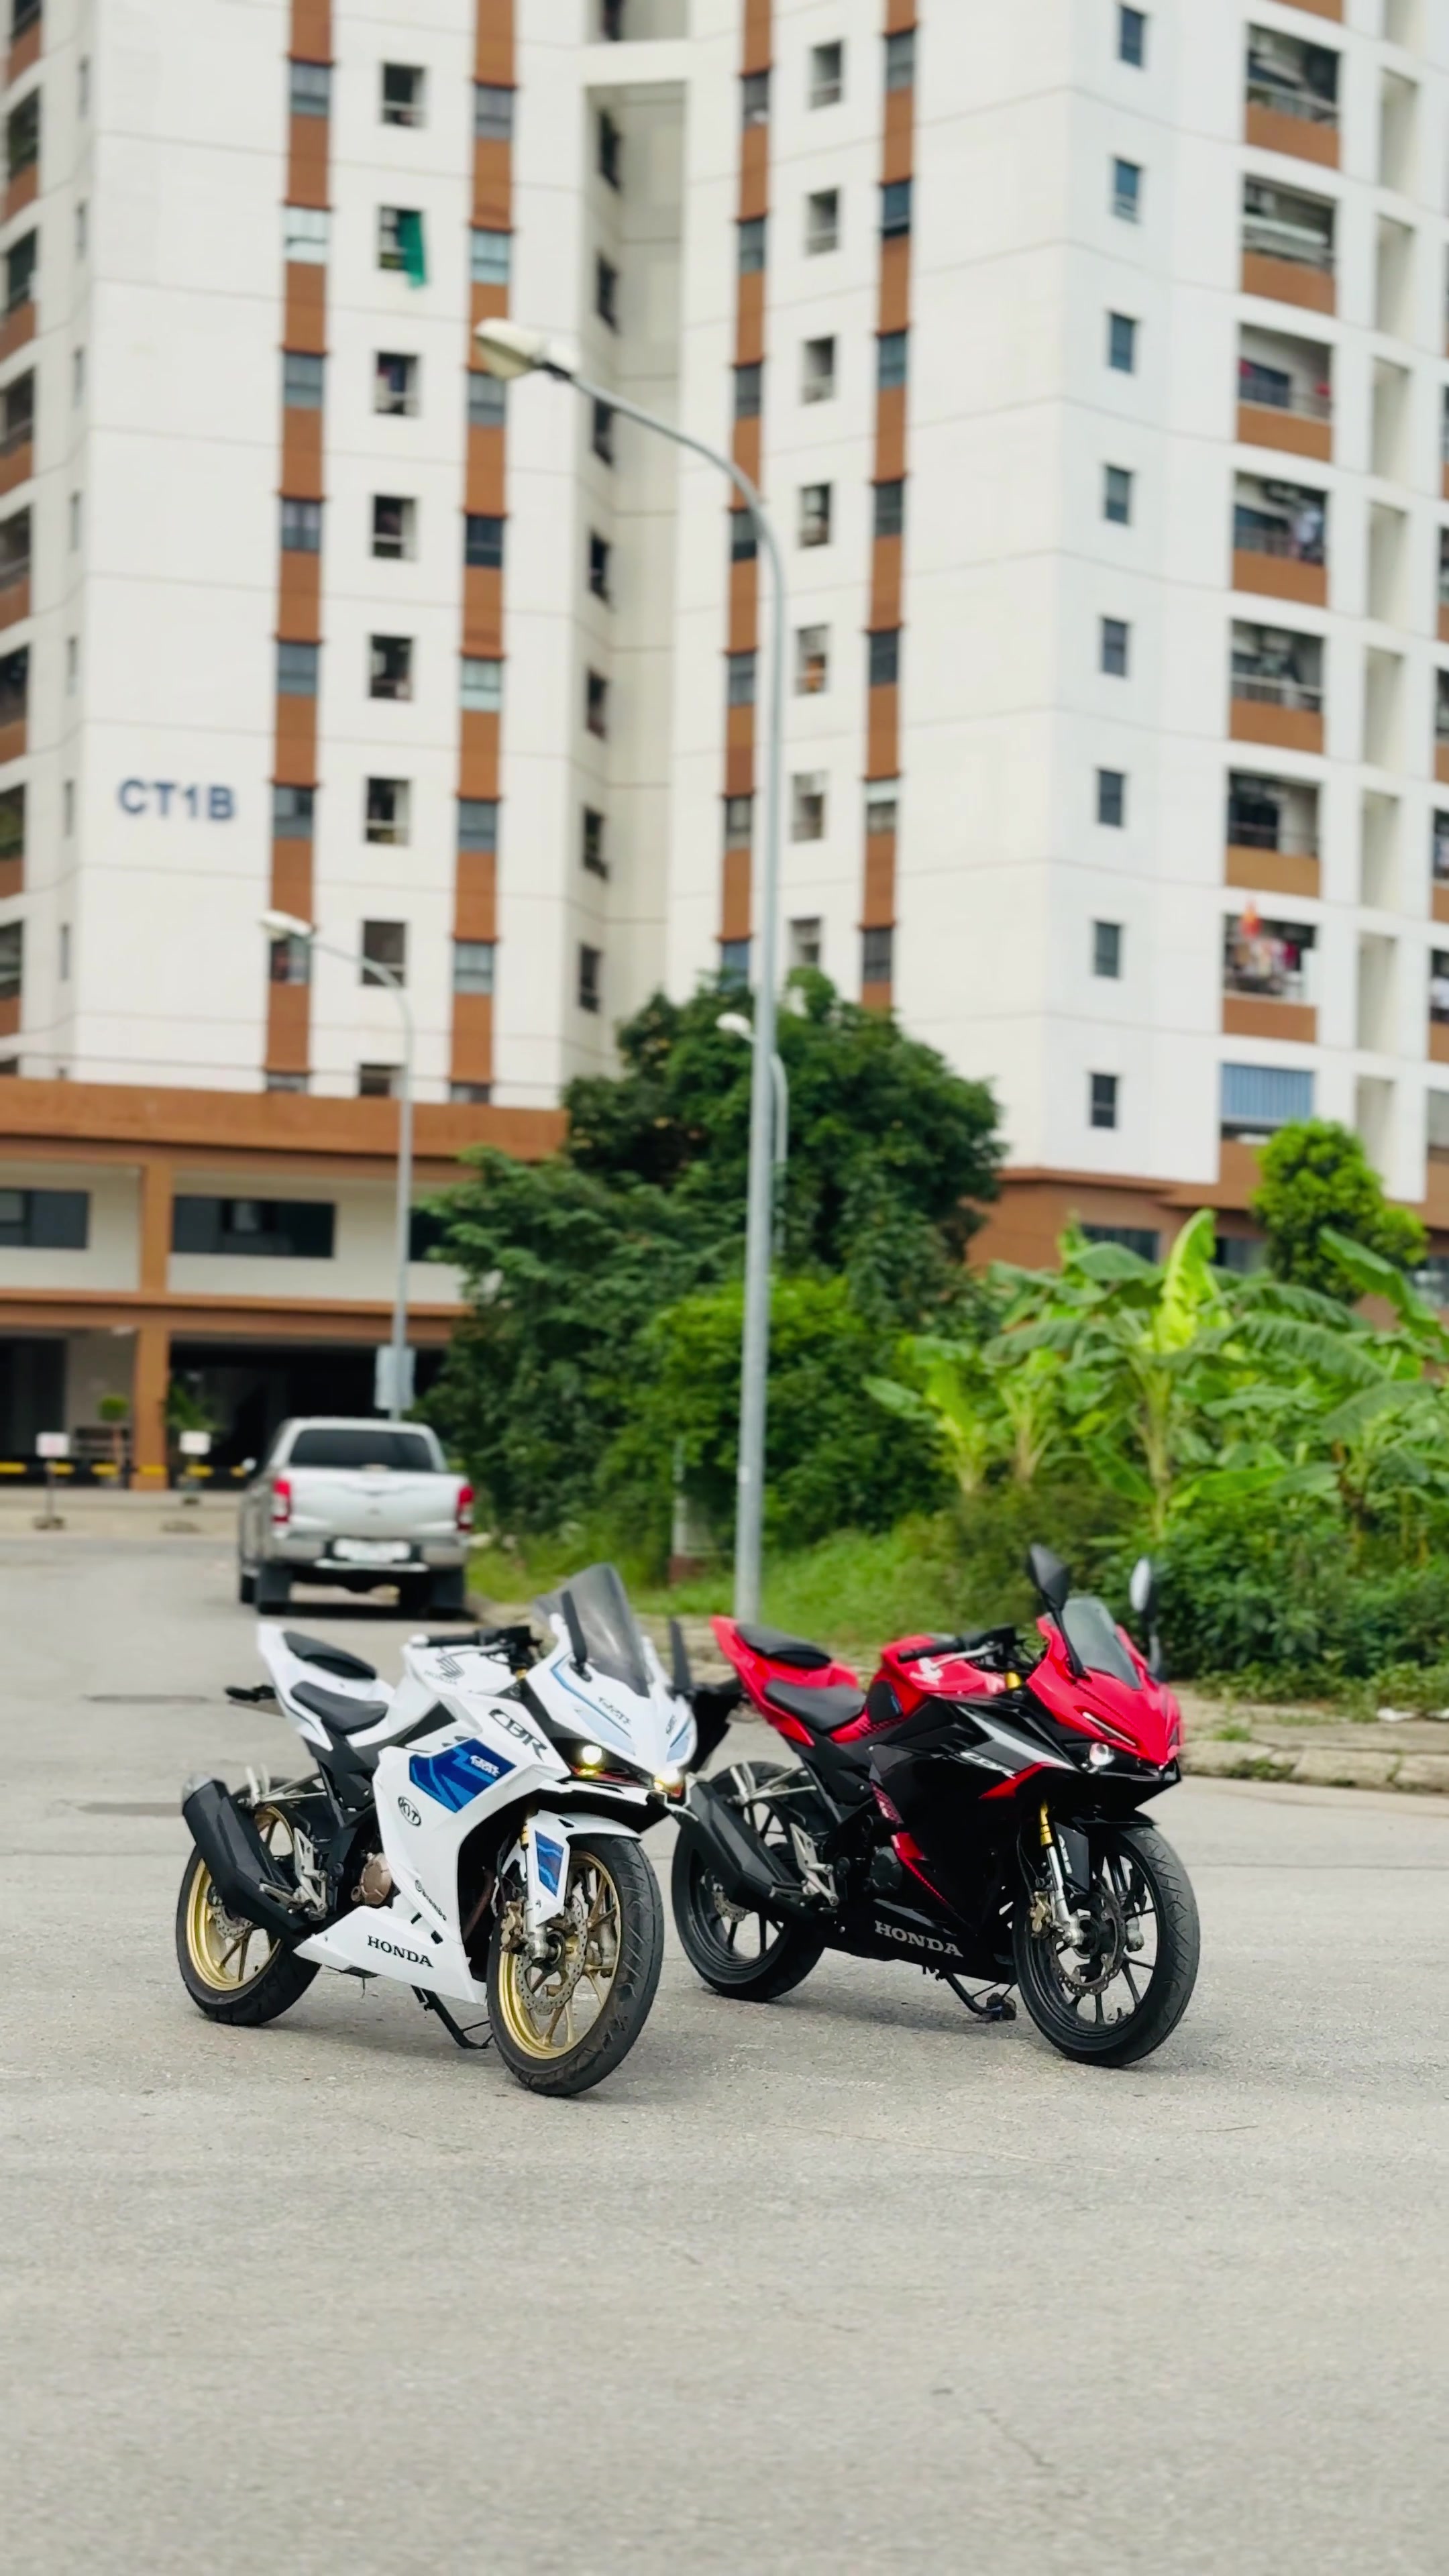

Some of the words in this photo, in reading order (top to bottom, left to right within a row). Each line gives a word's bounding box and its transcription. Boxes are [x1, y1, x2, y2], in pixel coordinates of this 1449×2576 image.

[118, 777, 236, 820] CT1B
[488, 1708, 547, 1763] CBR
[367, 1935, 434, 1968] HONDA
[874, 1919, 964, 1957] HONDA
